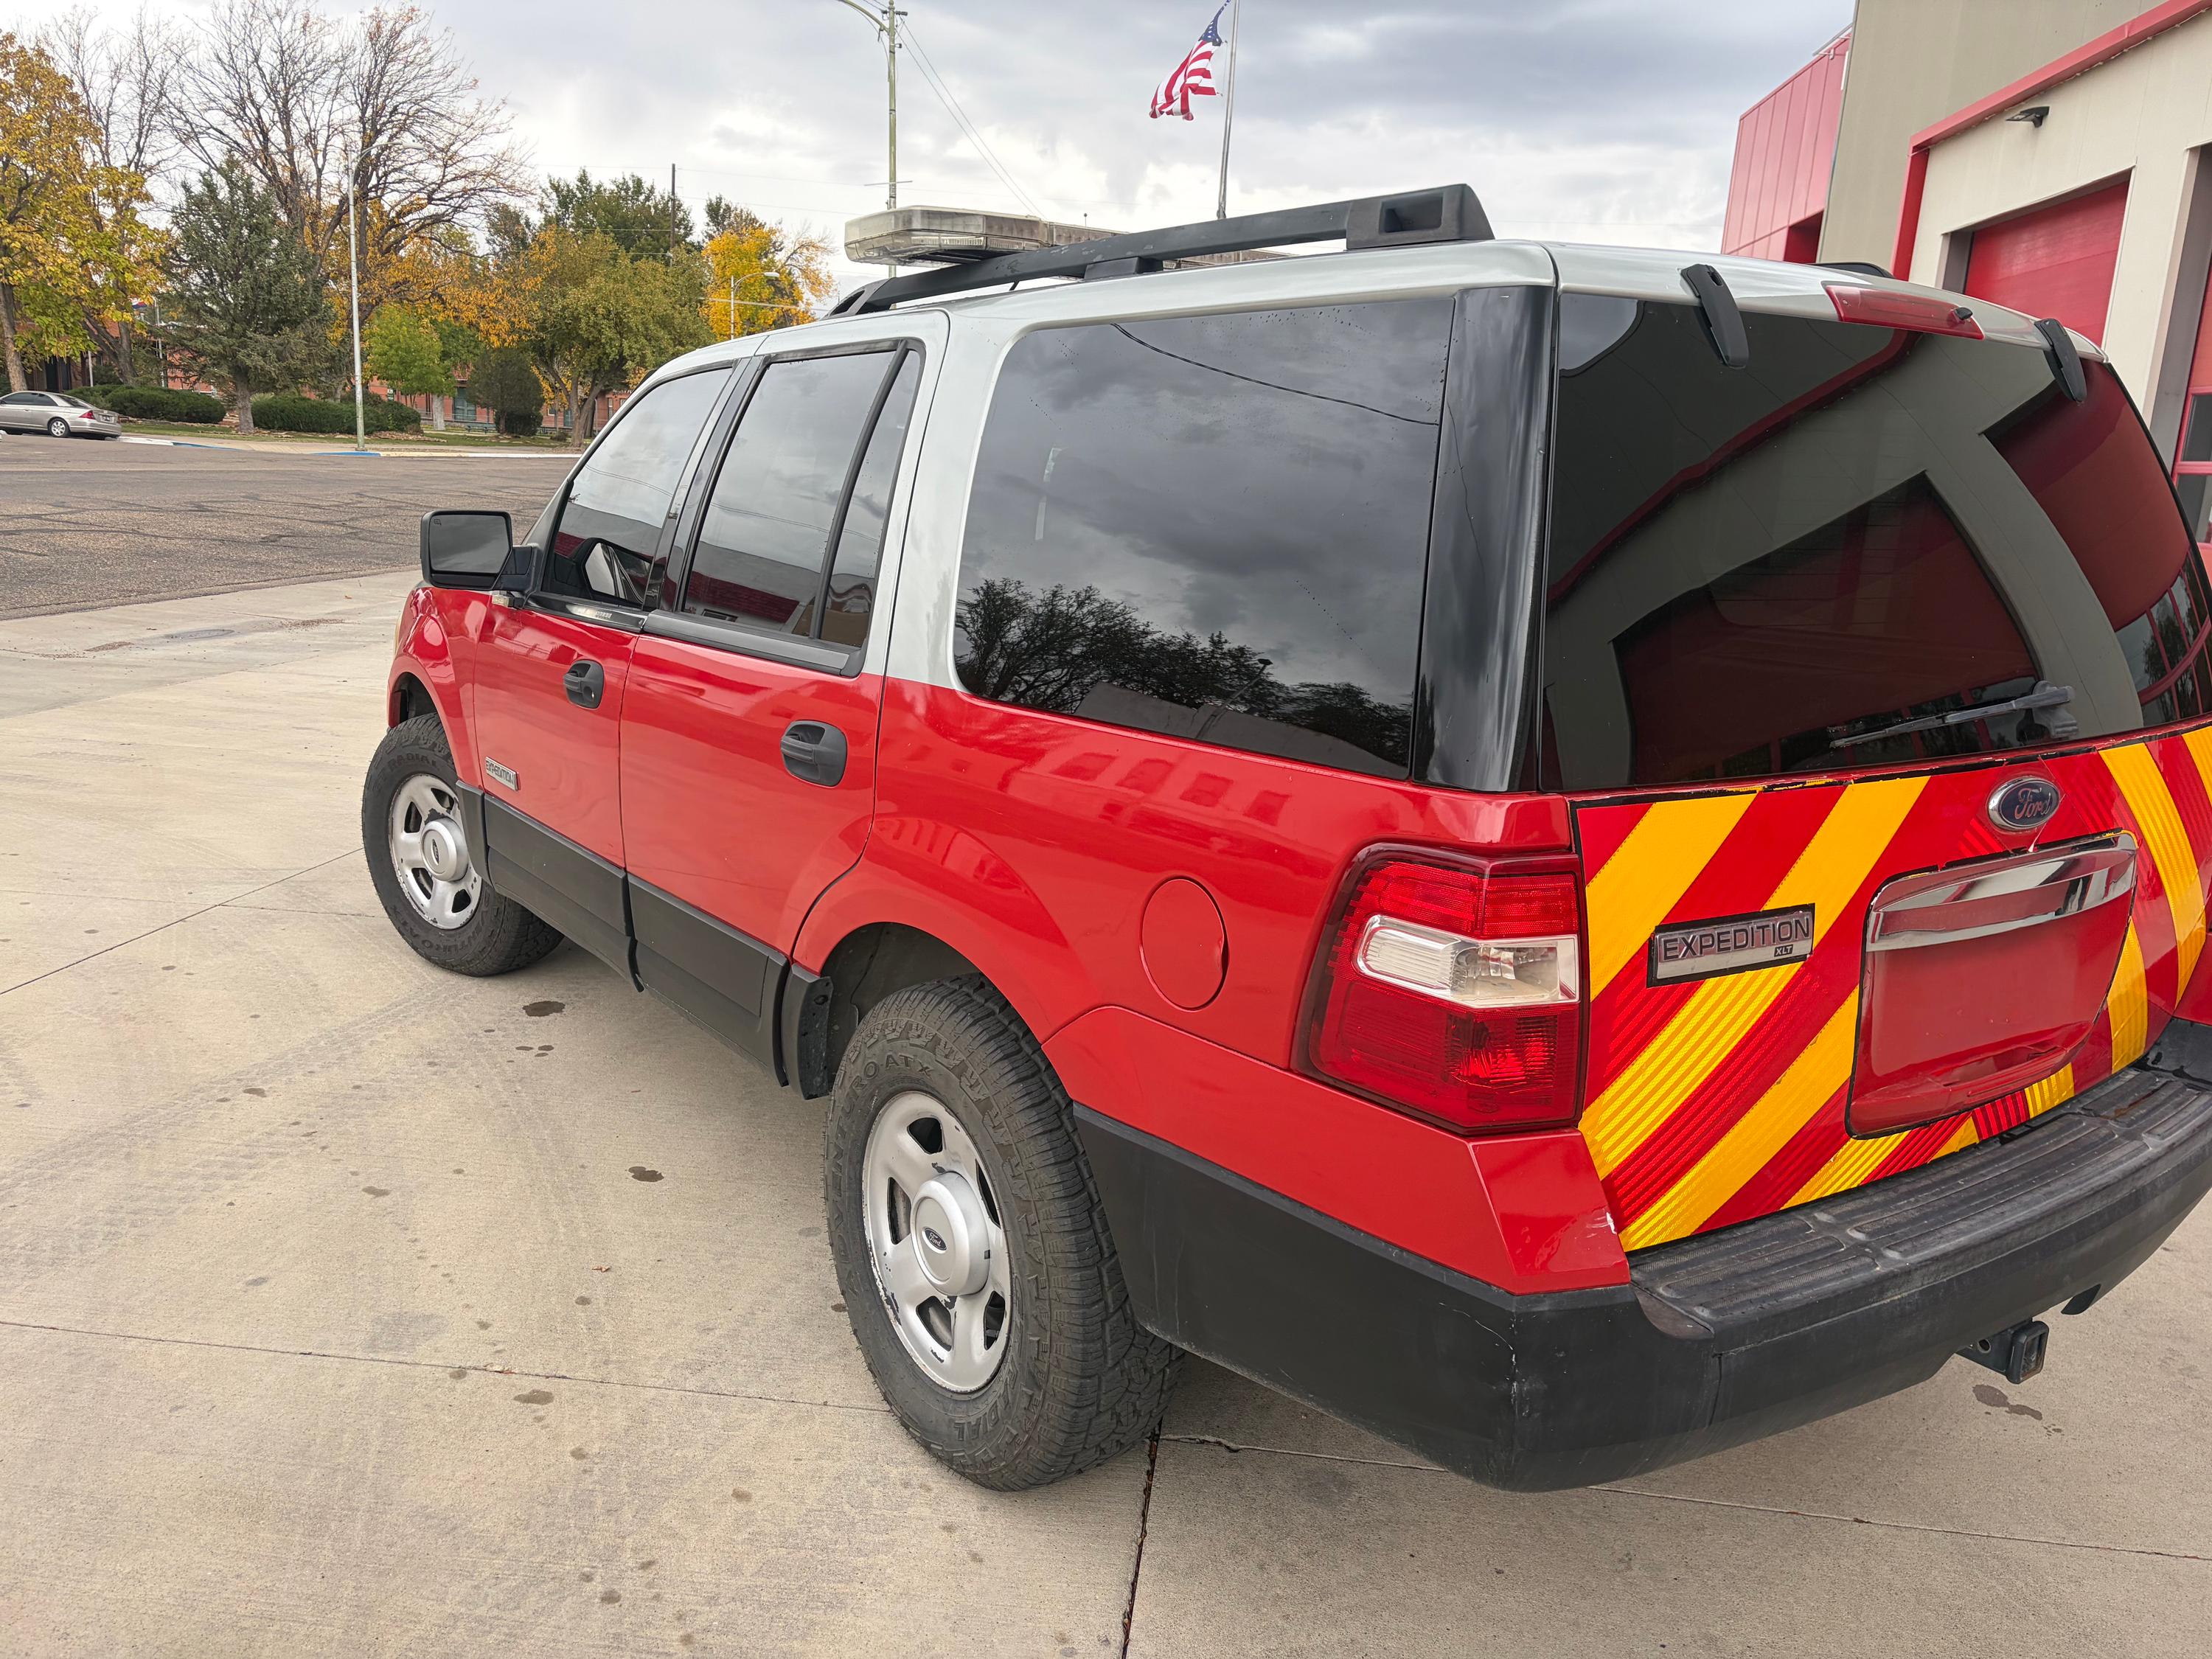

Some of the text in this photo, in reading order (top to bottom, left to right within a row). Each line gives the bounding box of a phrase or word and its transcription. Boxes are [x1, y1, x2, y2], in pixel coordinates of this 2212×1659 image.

[486, 759, 515, 785] EXPEDITION
[2014, 787, 2051, 820] Ford
[1663, 917, 1809, 961] EXPEDITION
[1775, 946, 1792, 956] XLT
[928, 1231, 942, 1247] Ford
